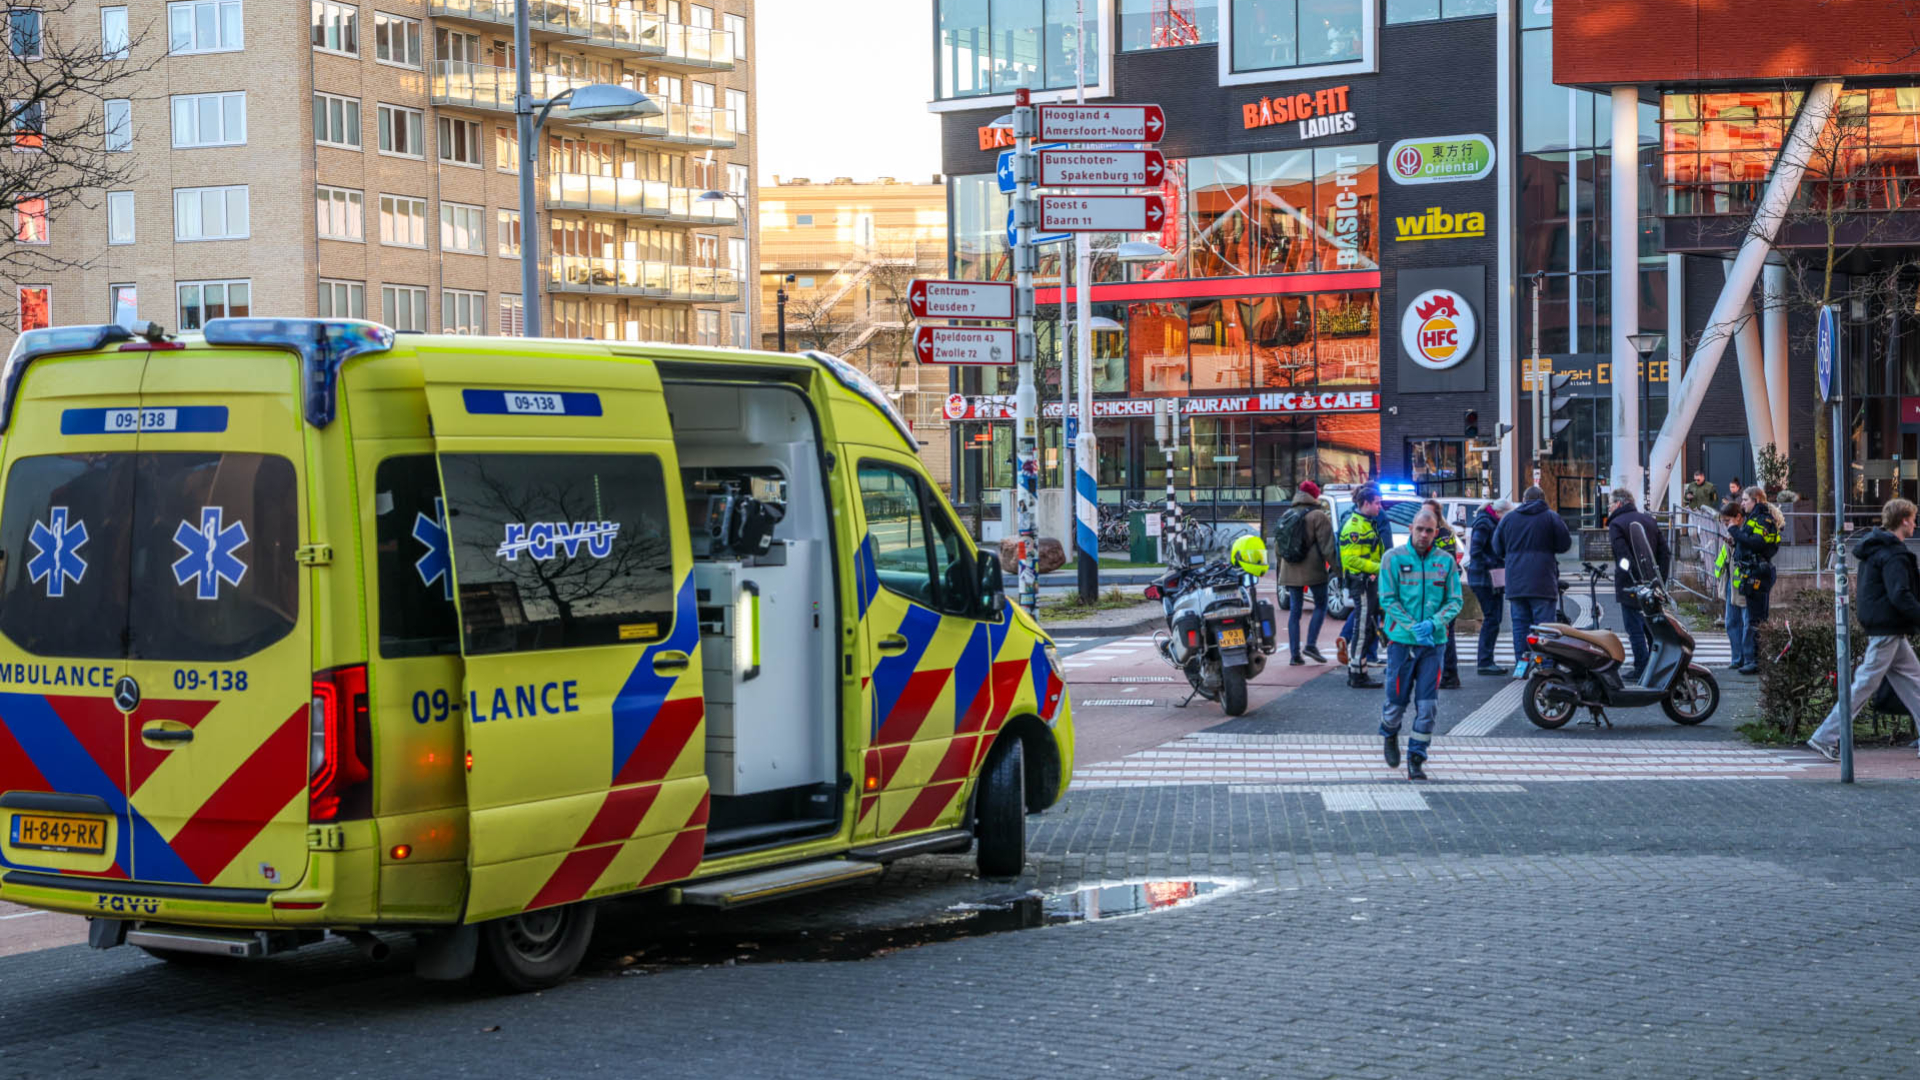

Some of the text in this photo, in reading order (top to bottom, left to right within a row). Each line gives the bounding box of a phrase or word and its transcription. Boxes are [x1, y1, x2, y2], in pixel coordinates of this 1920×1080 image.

[1242, 85, 1350, 130] BASIC-FIT
[1045, 110, 1099, 121] Hoogland
[1045, 126, 1144, 136] Amersfoort-Noord
[1299, 112, 1357, 140] LADIES
[1432, 143, 1474, 158] 東方行
[1045, 155, 1118, 165] Bunschoten-
[1425, 160, 1479, 175] Oriental
[1061, 170, 1129, 182] Spakenburg
[1046, 200, 1087, 209] Soest 6
[1336, 153, 1358, 266] BASIC-FIT
[1046, 216, 1092, 225] Baarn 11
[1395, 206, 1486, 236] wibra
[928, 285, 969, 296] Centrum
[928, 301, 975, 312] Leusden 7
[935, 332, 995, 343] Apeldoorn 43
[1423, 328, 1458, 348] HFC
[935, 348, 977, 358] Zwolle 72
[514, 396, 556, 410] 09-138
[1093, 401, 1153, 415] CHICKEN
[1259, 392, 1297, 410] HFC
[1319, 392, 1373, 408] CAFE
[115, 412, 166, 428] 09-138
[496, 521, 620, 561] ravu
[174, 669, 248, 691] 09-138
[469, 680, 579, 723] LANCE
[23, 820, 98, 844] H-849-RK
[97, 895, 160, 914] ravu
